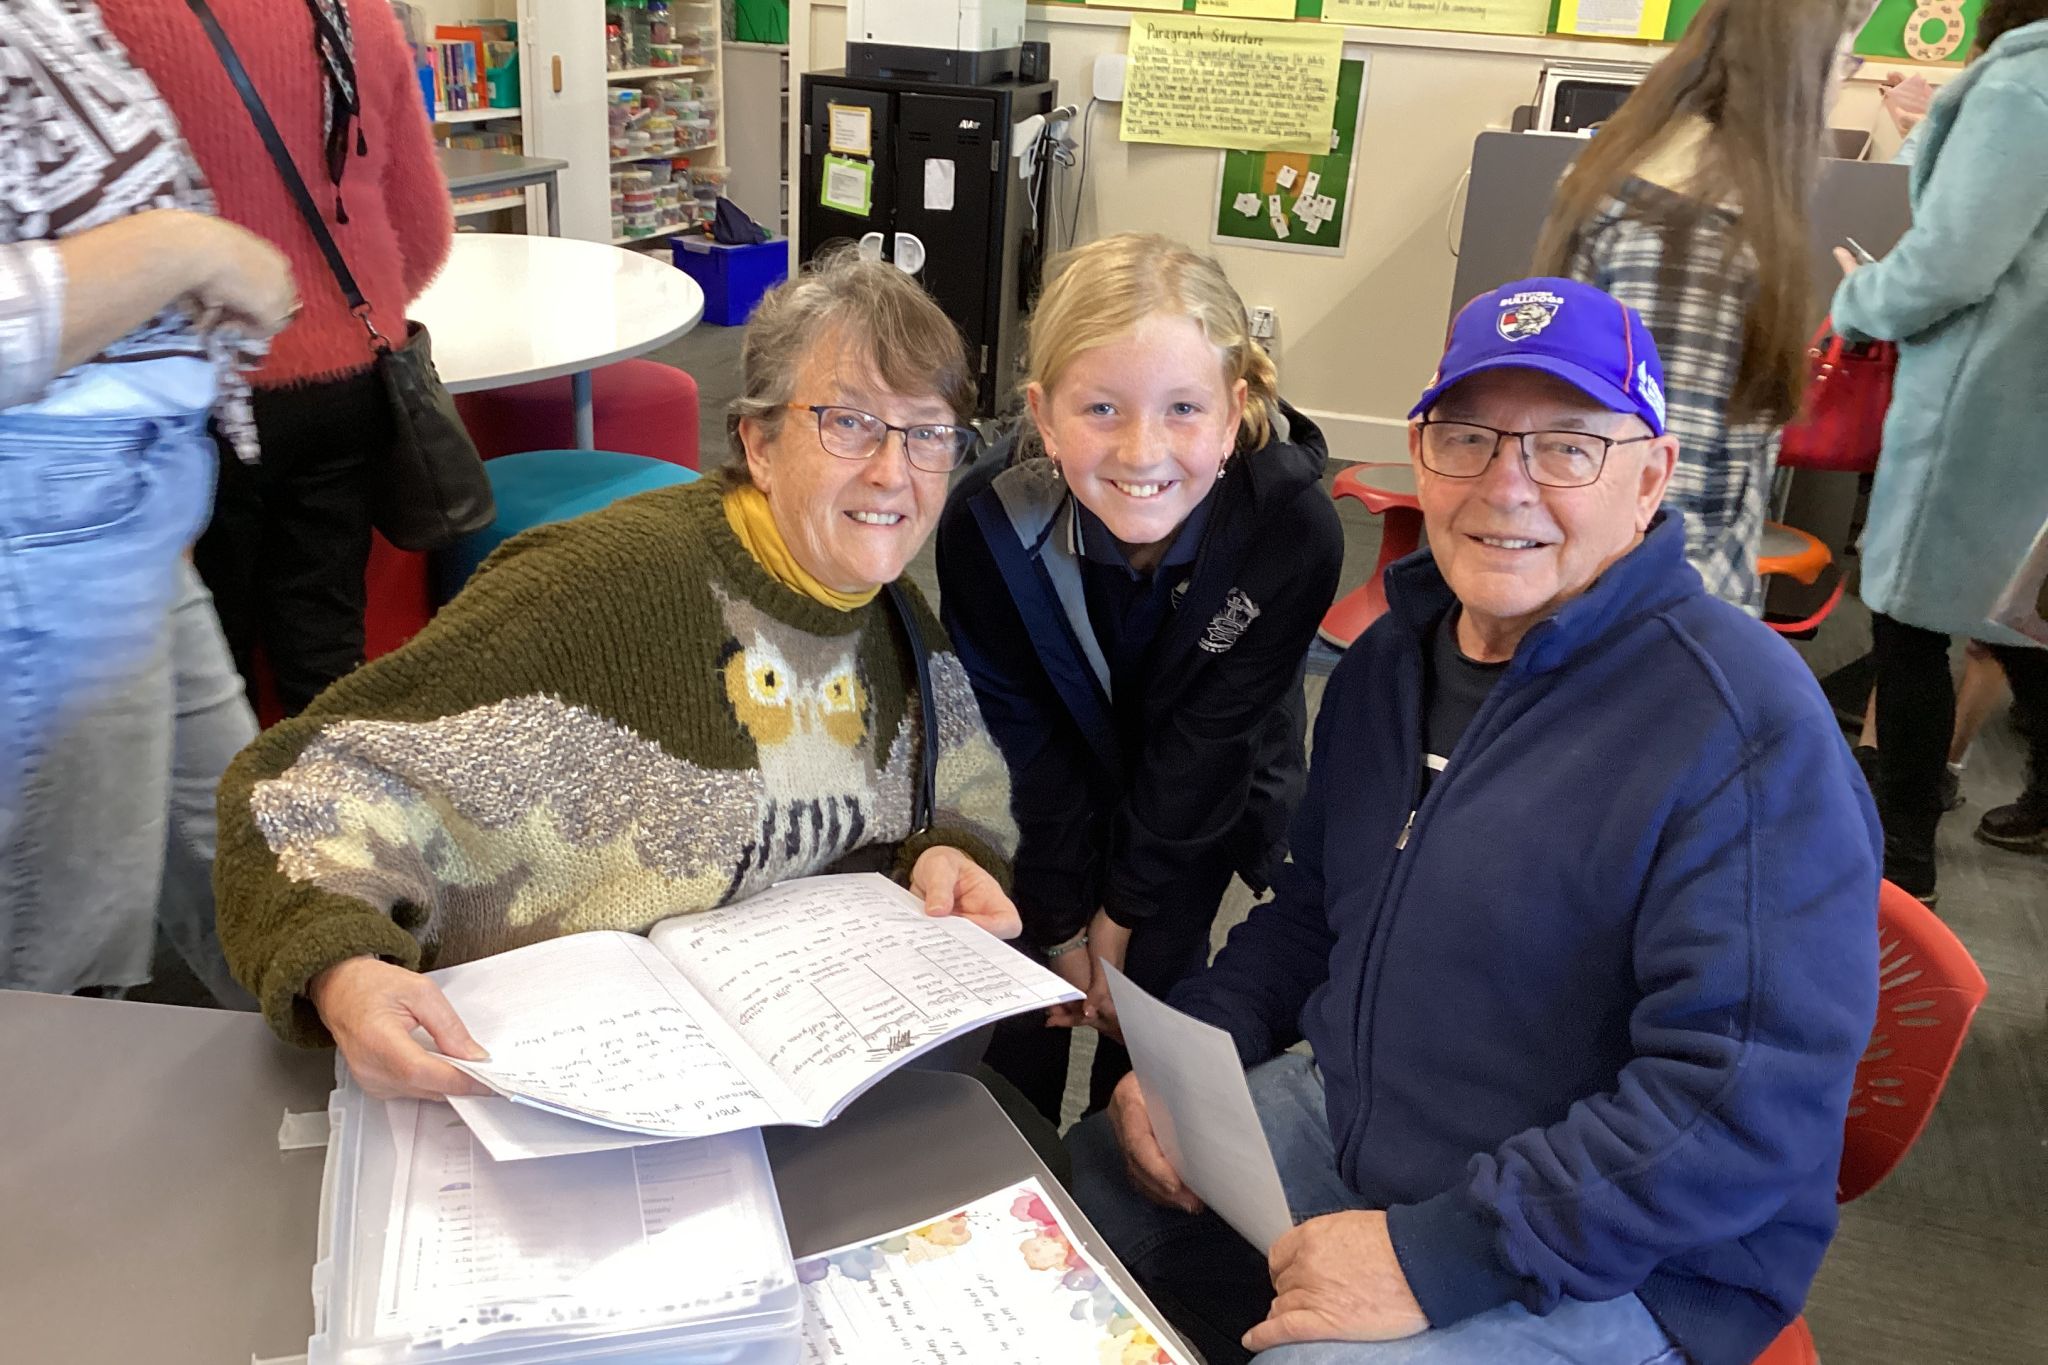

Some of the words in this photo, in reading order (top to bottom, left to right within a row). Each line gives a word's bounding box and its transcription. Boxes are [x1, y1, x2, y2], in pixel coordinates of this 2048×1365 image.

[1147, 22, 1204, 44] Paragraph
[1212, 28, 1264, 46] Structure
[1936, 47, 1947, 55] 72
[1499, 294, 1564, 306] BULLDOGS
[716, 1089, 763, 1101] Because
[663, 1103, 682, 1114] you
[694, 1099, 704, 1110] of
[707, 1105, 740, 1121] more
